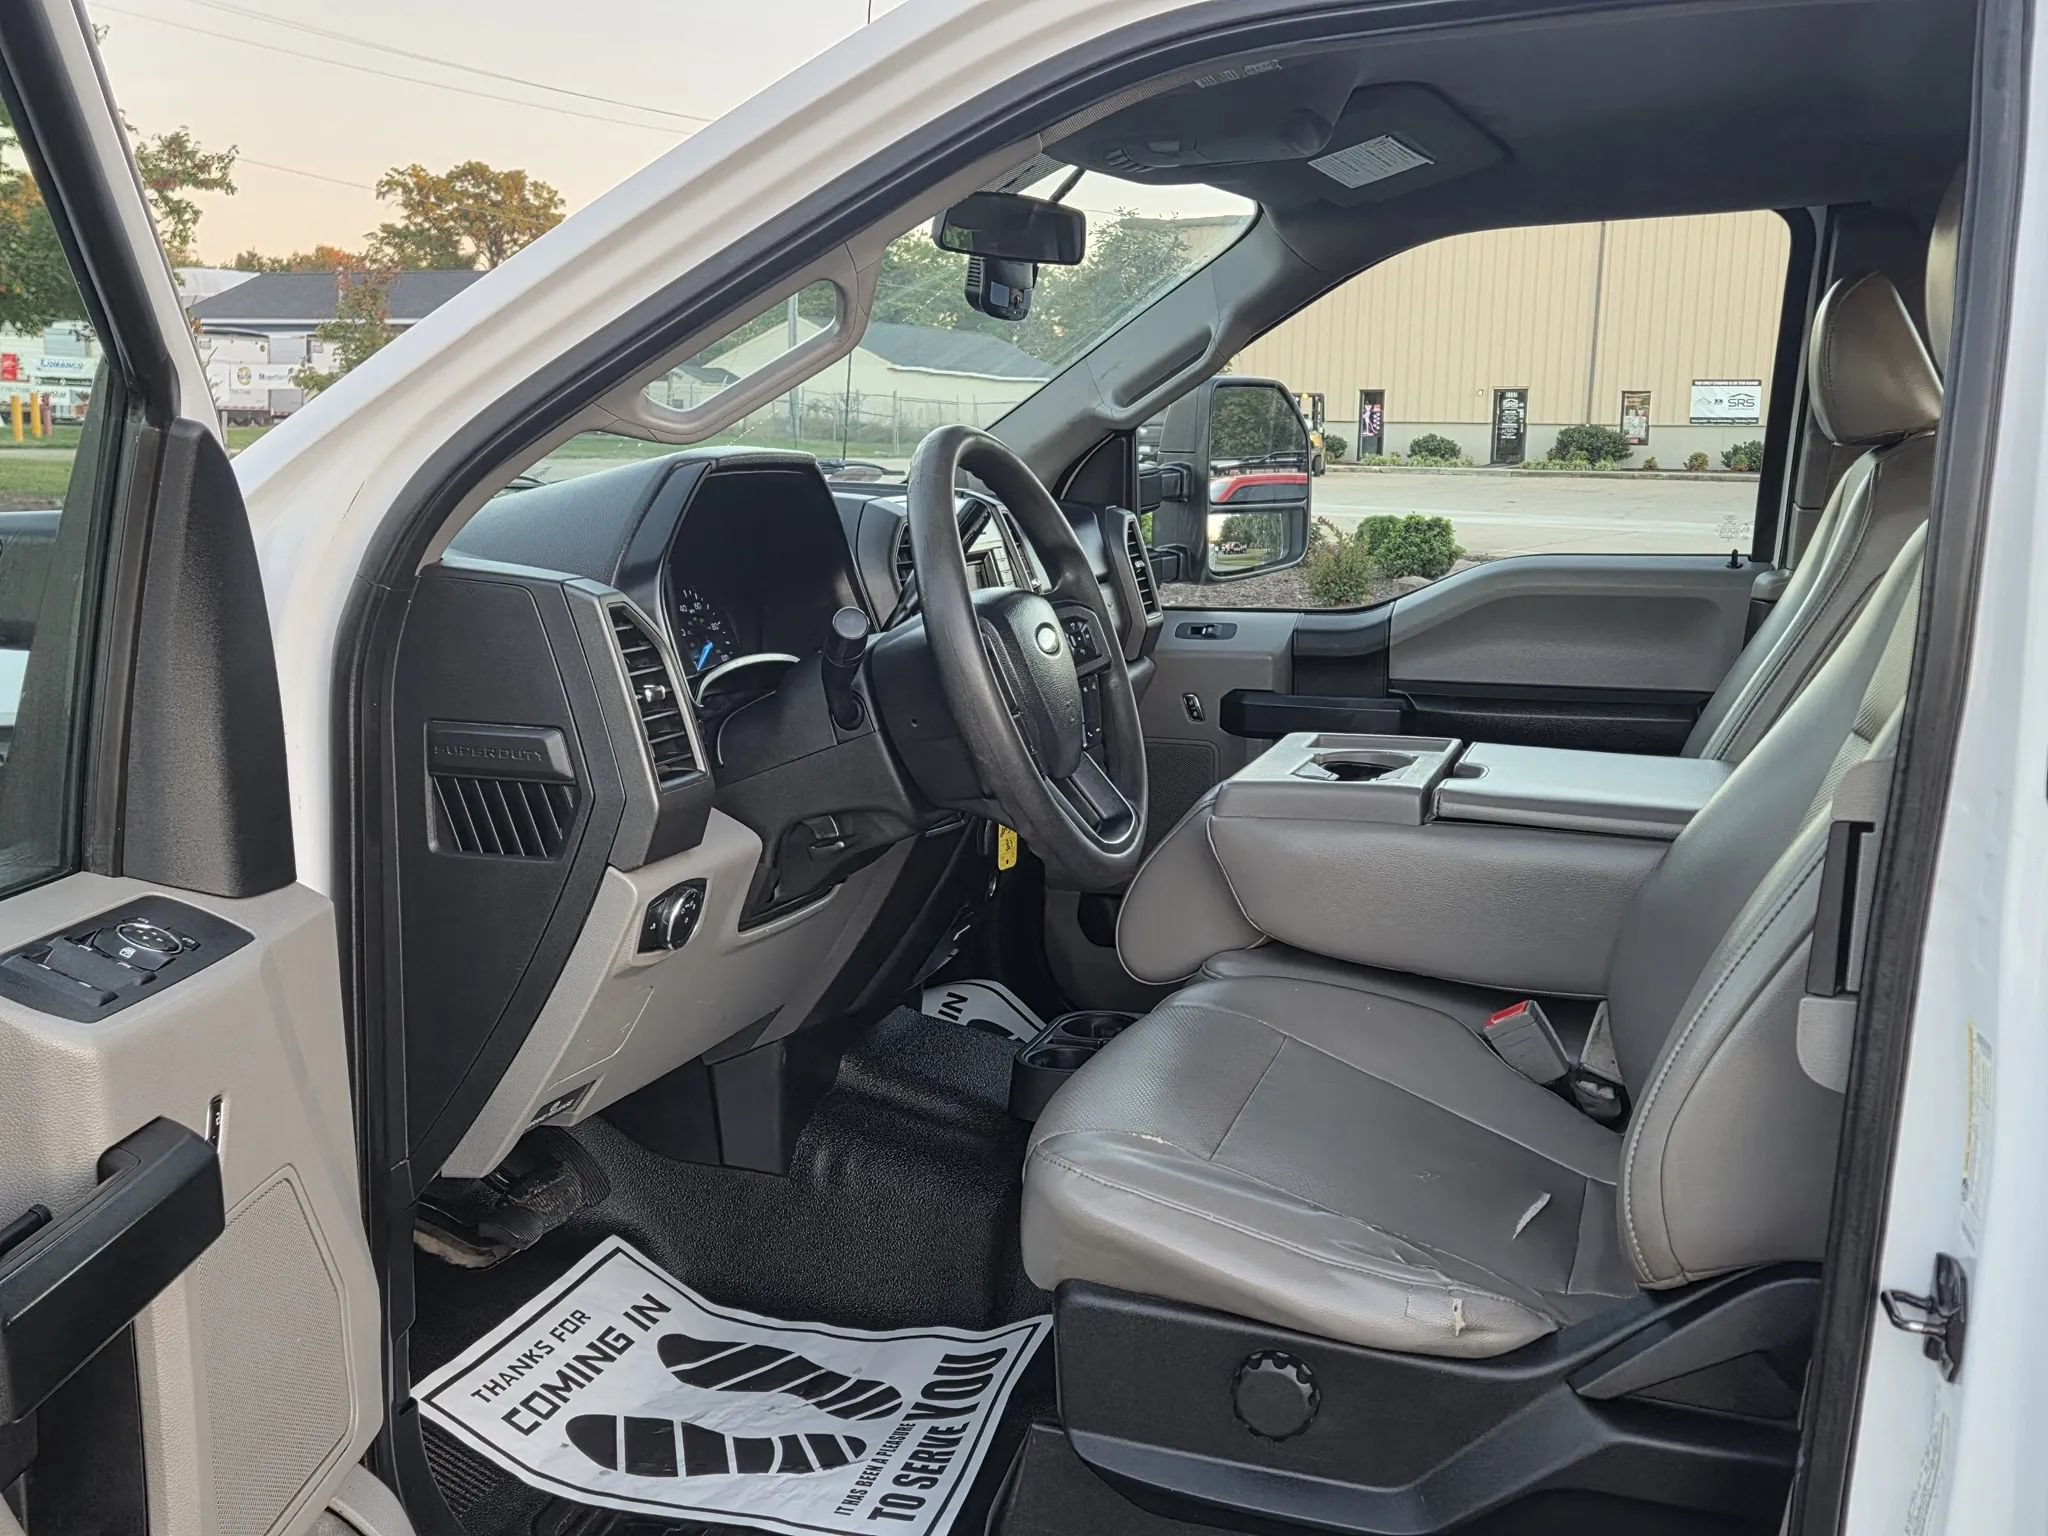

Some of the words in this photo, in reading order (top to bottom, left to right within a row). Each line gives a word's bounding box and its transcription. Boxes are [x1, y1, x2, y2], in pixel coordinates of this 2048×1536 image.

[1727, 398, 1755, 408] SRS
[434, 745, 496, 758] SUPER
[498, 749, 544, 761] DUTY
[938, 991, 969, 1021] IN
[470, 1339, 555, 1403] THANKS
[549, 1309, 591, 1343] FOR
[501, 1325, 636, 1436] COMING
[622, 1293, 672, 1332] IN
[902, 1348, 1008, 1421] YOU
[875, 1422, 916, 1457] PLEASURE
[871, 1457, 889, 1465] A
[892, 1421, 970, 1490] SERVE
[855, 1464, 885, 1488] BEEN
[833, 1506, 854, 1516] IT
[842, 1488, 868, 1506] HAS
[867, 1492, 926, 1521] TO
